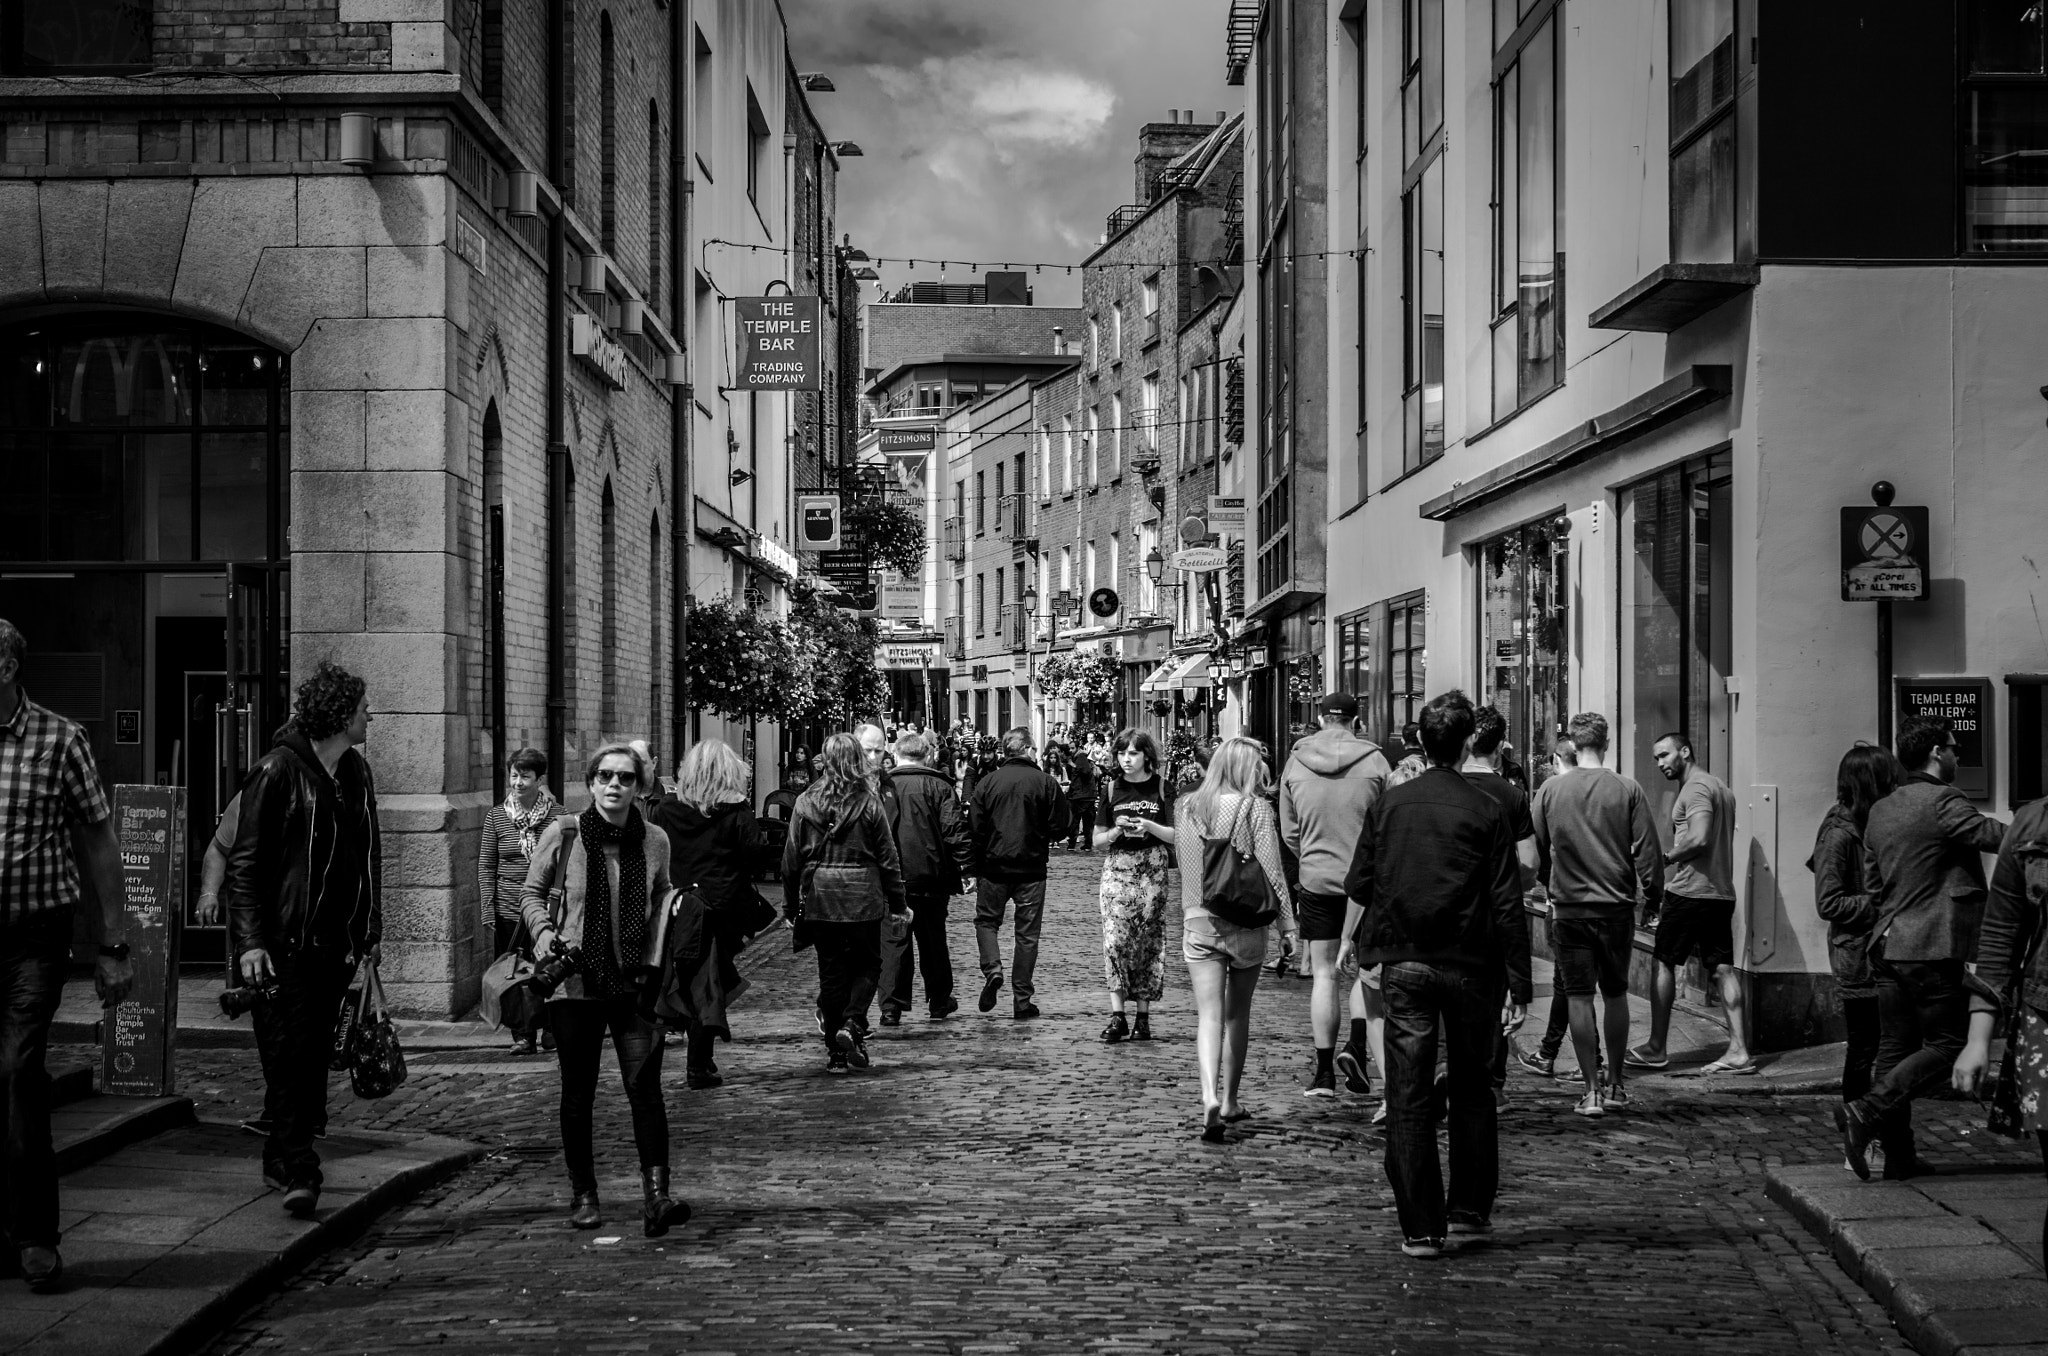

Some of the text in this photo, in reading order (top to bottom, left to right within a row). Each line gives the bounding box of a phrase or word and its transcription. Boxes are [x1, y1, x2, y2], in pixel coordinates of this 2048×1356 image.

[760, 302, 794, 316] THE
[744, 320, 811, 334] TEMPLE
[759, 338, 795, 351] BAR
[752, 362, 803, 372] TRADING
[748, 374, 806, 384] COMPANY
[880, 434, 931, 444] FITZSIMONS
[841, 533, 867, 541] MPLE
[841, 542, 857, 550] AR
[1177, 558, 1224, 567] Botticelli
[1889, 583, 1916, 591] TIMES
[889, 648, 933, 656] FITZSIMONS
[1909, 693, 1976, 705] TEMPLE BAR
[1920, 706, 1967, 718] GALLERY
[122, 805, 167, 820] Temple
[121, 817, 144, 829] Bar
[120, 829, 154, 841] Book
[120, 841, 165, 853] Market
[120, 852, 150, 864] Here
[124, 876, 142, 885] very
[125, 885, 154, 895] turday
[127, 894, 157, 904] Sunday
[116, 1020, 144, 1028] Temple
[115, 1032, 146, 1040] Cultural
